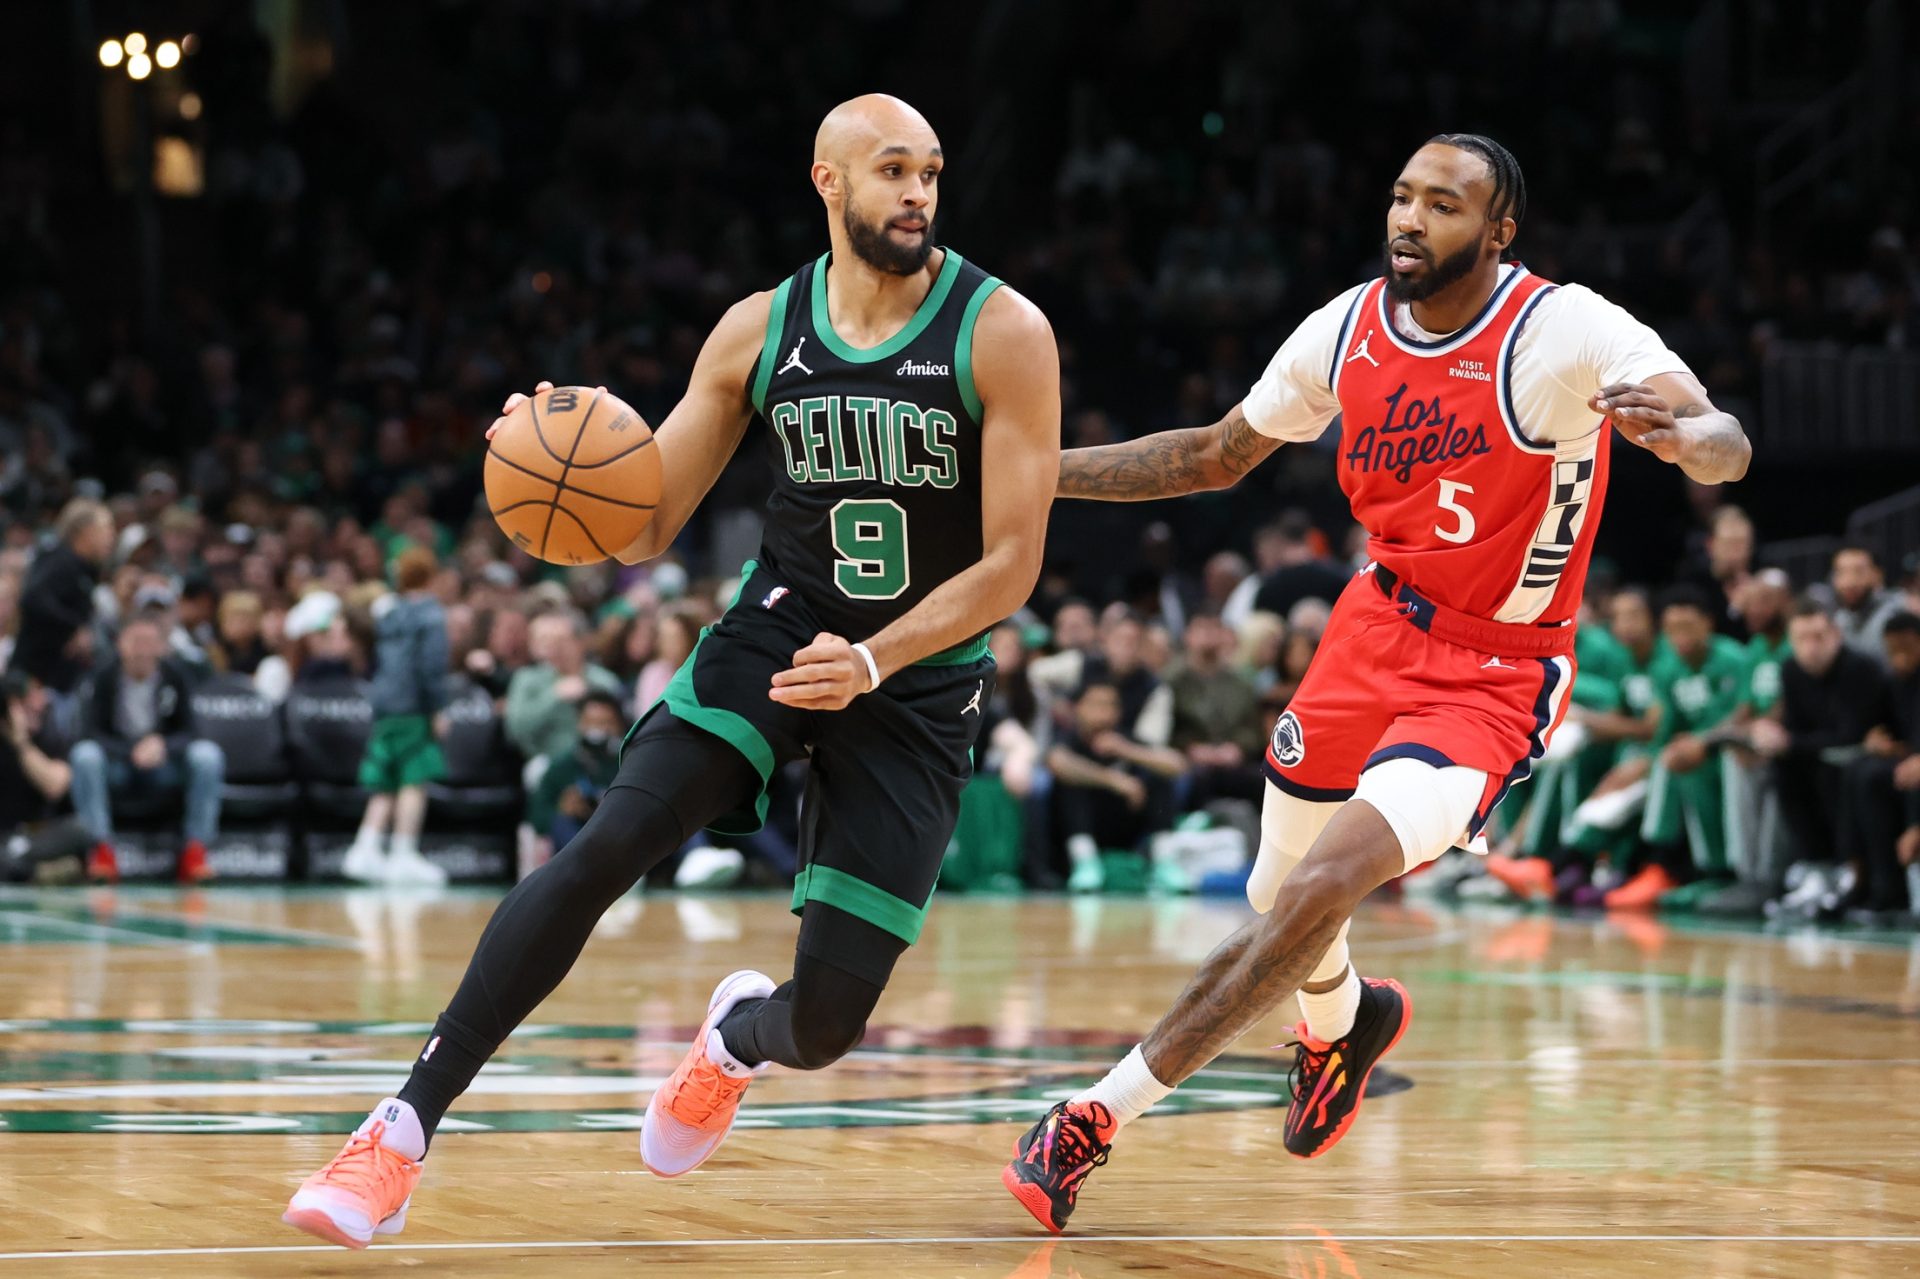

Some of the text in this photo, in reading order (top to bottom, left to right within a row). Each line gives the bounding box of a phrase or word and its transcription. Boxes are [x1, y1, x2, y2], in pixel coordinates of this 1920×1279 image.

[896, 359, 949, 376] Amica
[1448, 367, 1491, 382] RWANDA
[1458, 359, 1484, 371] VISIT
[1380, 382, 1445, 434] Los
[772, 395, 960, 489] CELTICS
[1346, 413, 1492, 484] Angeles
[1434, 477, 1476, 544] 5
[830, 498, 910, 600] 9
